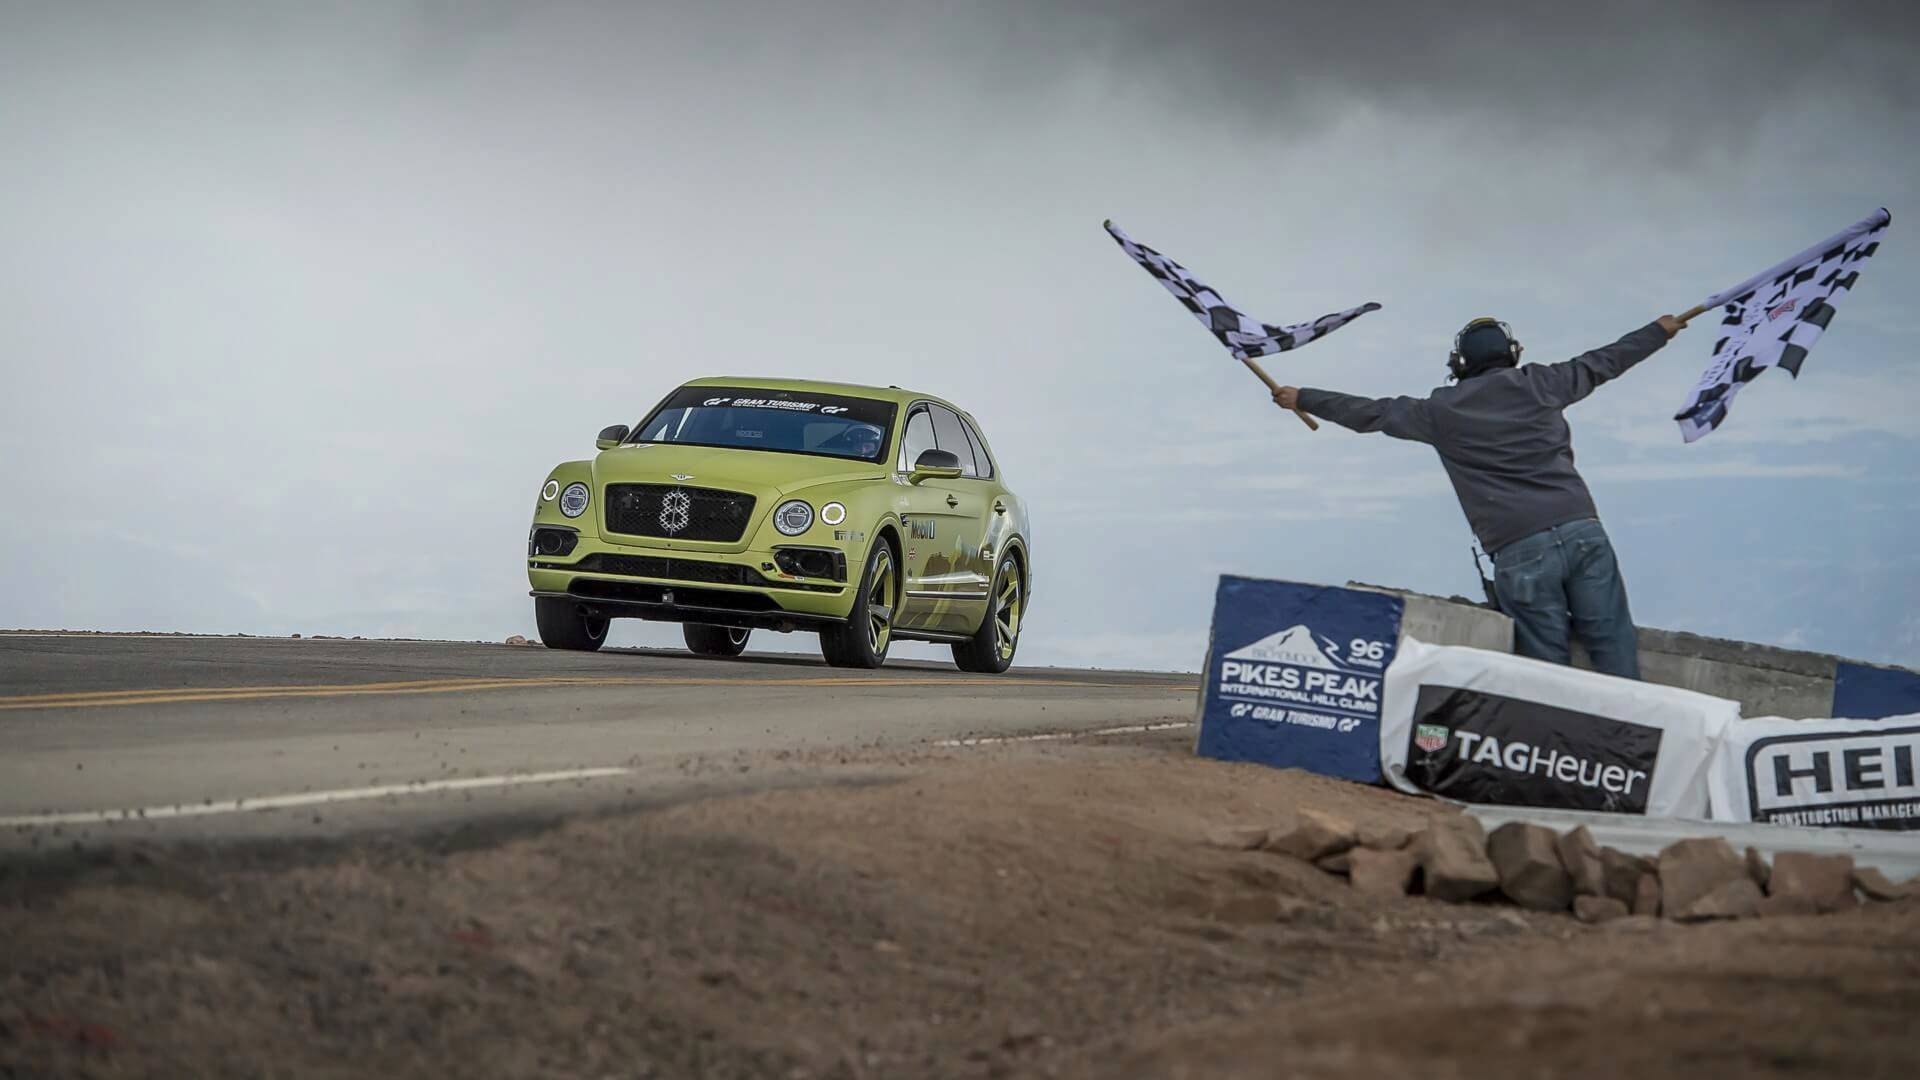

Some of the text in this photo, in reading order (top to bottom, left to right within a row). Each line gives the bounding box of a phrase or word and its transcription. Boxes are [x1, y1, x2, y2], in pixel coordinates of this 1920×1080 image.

[733, 398, 764, 406] GRAN
[1222, 661, 1379, 700] PIKES PEAK
[1220, 683, 1378, 713] INTERNATIONAL HILL CLIMB
[1252, 706, 1284, 722] GRAN
[1286, 711, 1338, 730] TURISMO
[1769, 807, 1859, 826] CONSTRUCTION
